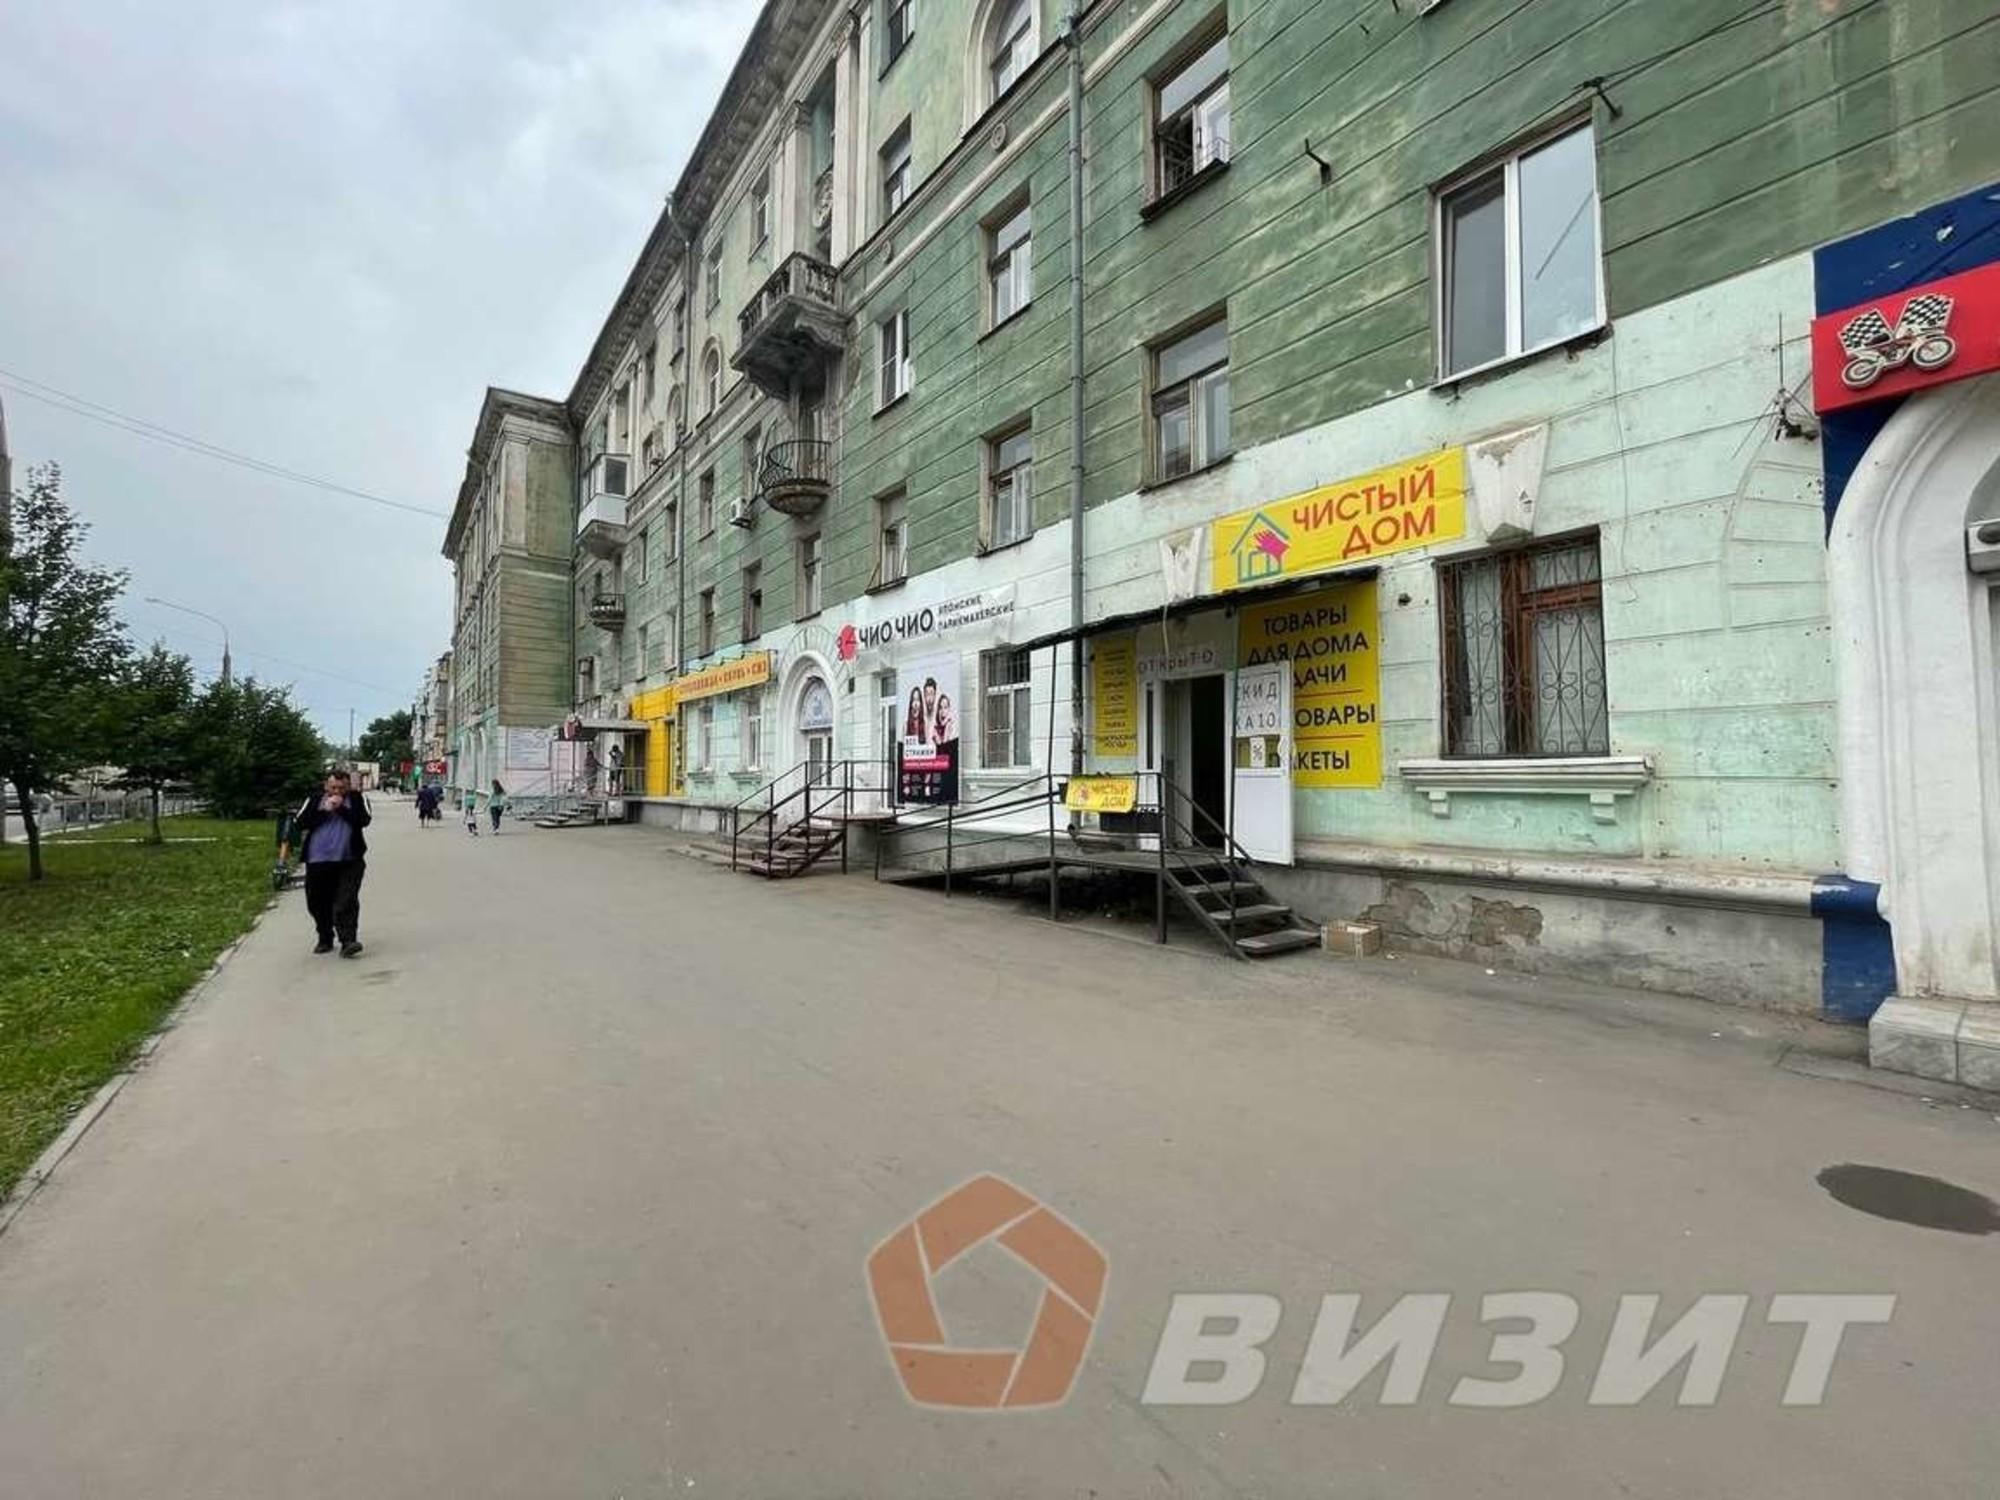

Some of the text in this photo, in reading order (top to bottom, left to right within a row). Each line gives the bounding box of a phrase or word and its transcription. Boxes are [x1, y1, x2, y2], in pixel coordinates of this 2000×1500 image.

[1292, 464, 1435, 532] ЧИСТЫЙ
[1341, 503, 1435, 559] ДОМ
[858, 608, 934, 648] ЧИО ЧИО
[1264, 605, 1347, 635] ТОВАРЫ
[1248, 631, 1369, 667] ДЛЯ ДОМА
[1294, 703, 1376, 728] ОВАРЫ
